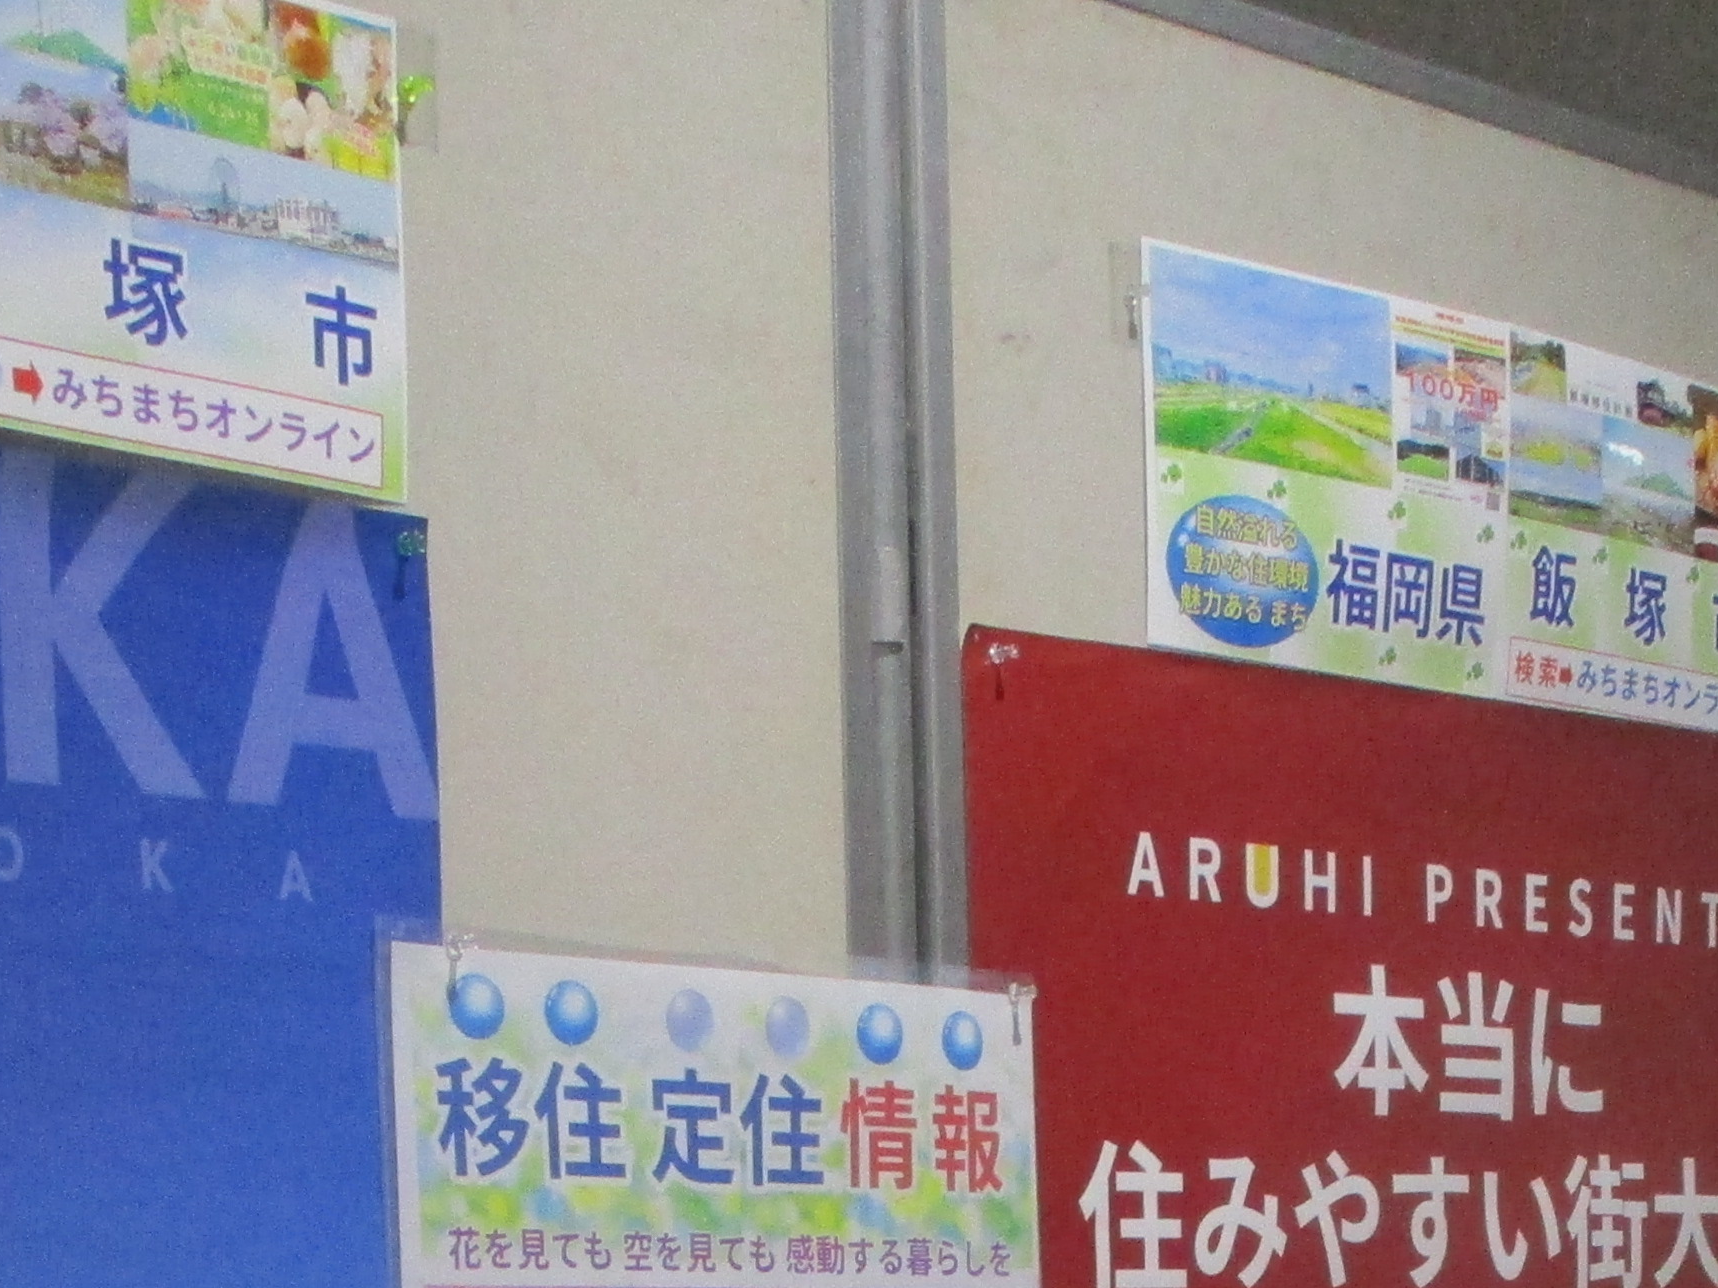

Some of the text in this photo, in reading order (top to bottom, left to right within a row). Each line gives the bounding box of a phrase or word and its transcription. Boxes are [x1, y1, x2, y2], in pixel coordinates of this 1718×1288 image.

[52, 368, 376, 464] みちまちオンライン
[1184, 543, 1310, 593] 豊かな住環境
[1197, 505, 1298, 550] 自然溢れる
[1326, 539, 1485, 647] 福岡県
[1514, 650, 1560, 688] 検索
[1127, 830, 1374, 917] ARUHI
[1331, 963, 1605, 1122] 本当に
